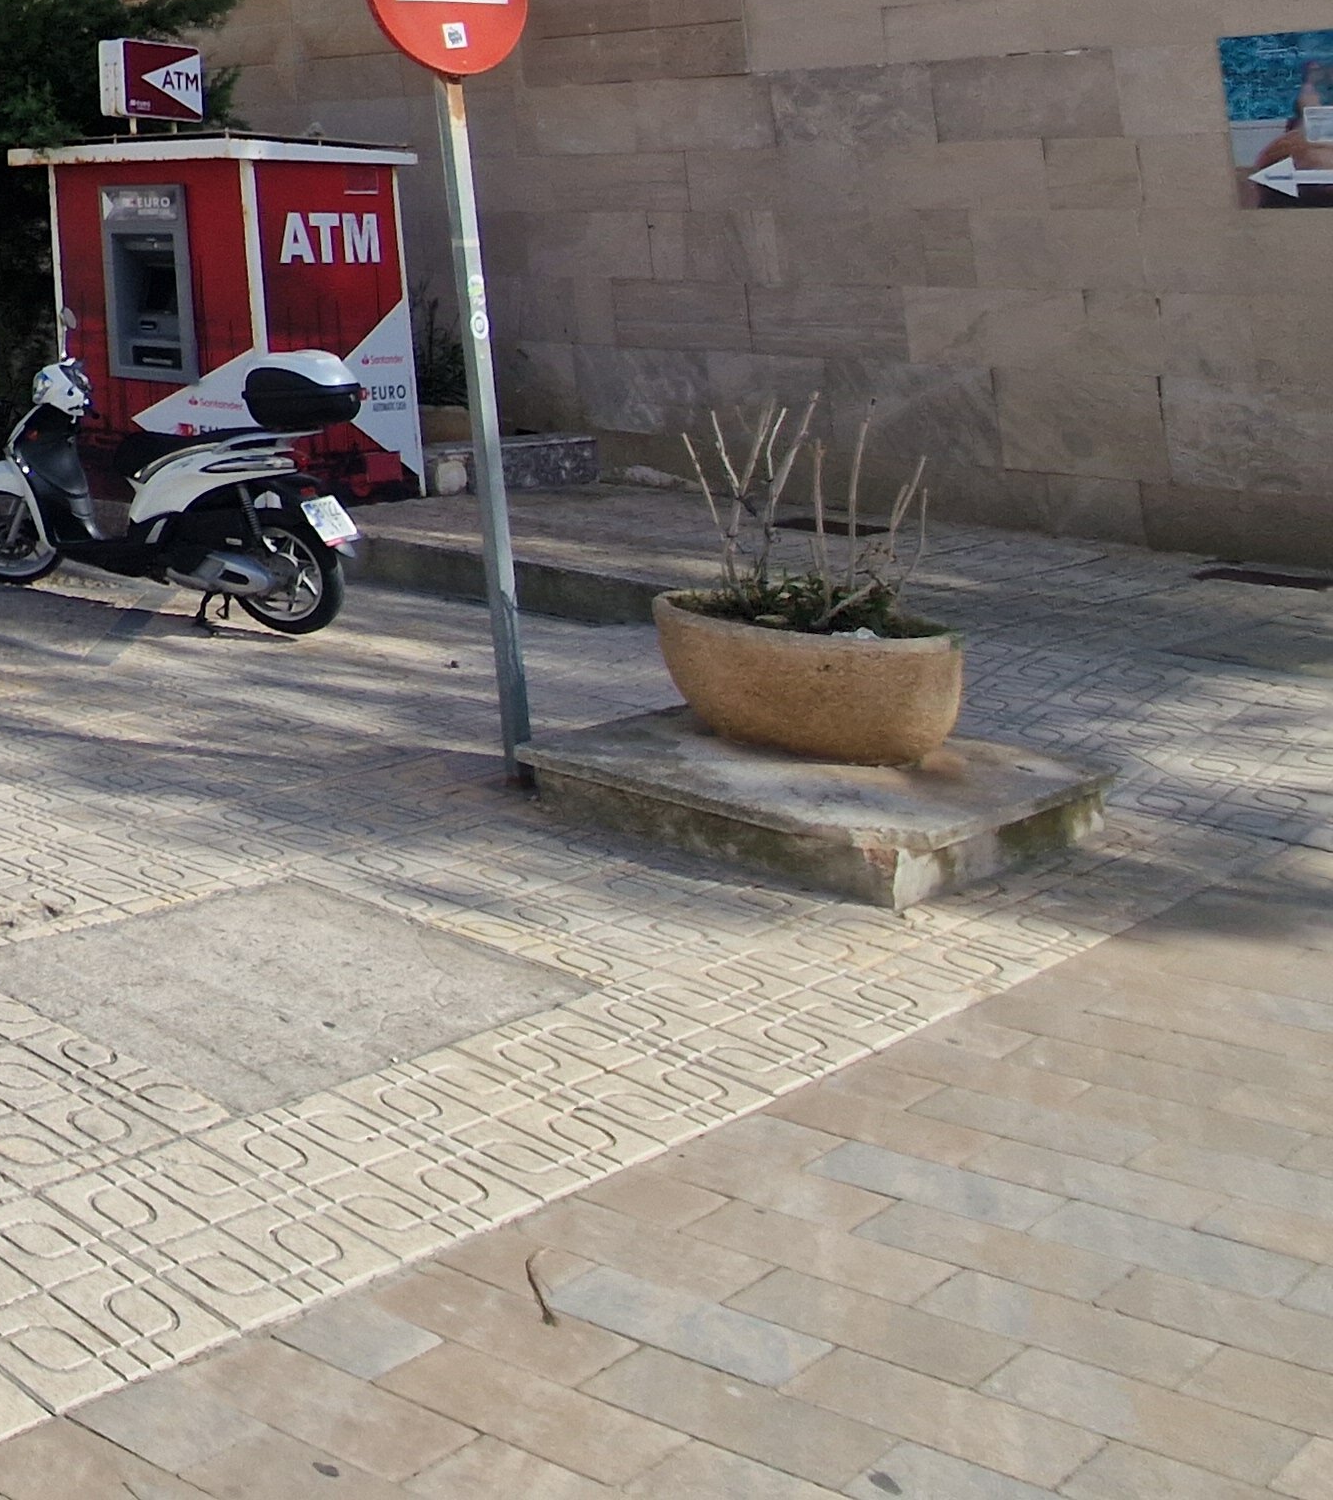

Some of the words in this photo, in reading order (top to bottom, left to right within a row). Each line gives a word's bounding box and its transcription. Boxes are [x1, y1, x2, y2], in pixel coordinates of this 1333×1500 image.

[162, 69, 199, 92] ATM
[137, 196, 171, 208] EURO
[279, 212, 381, 264] ATM
[371, 384, 406, 400] EURO
